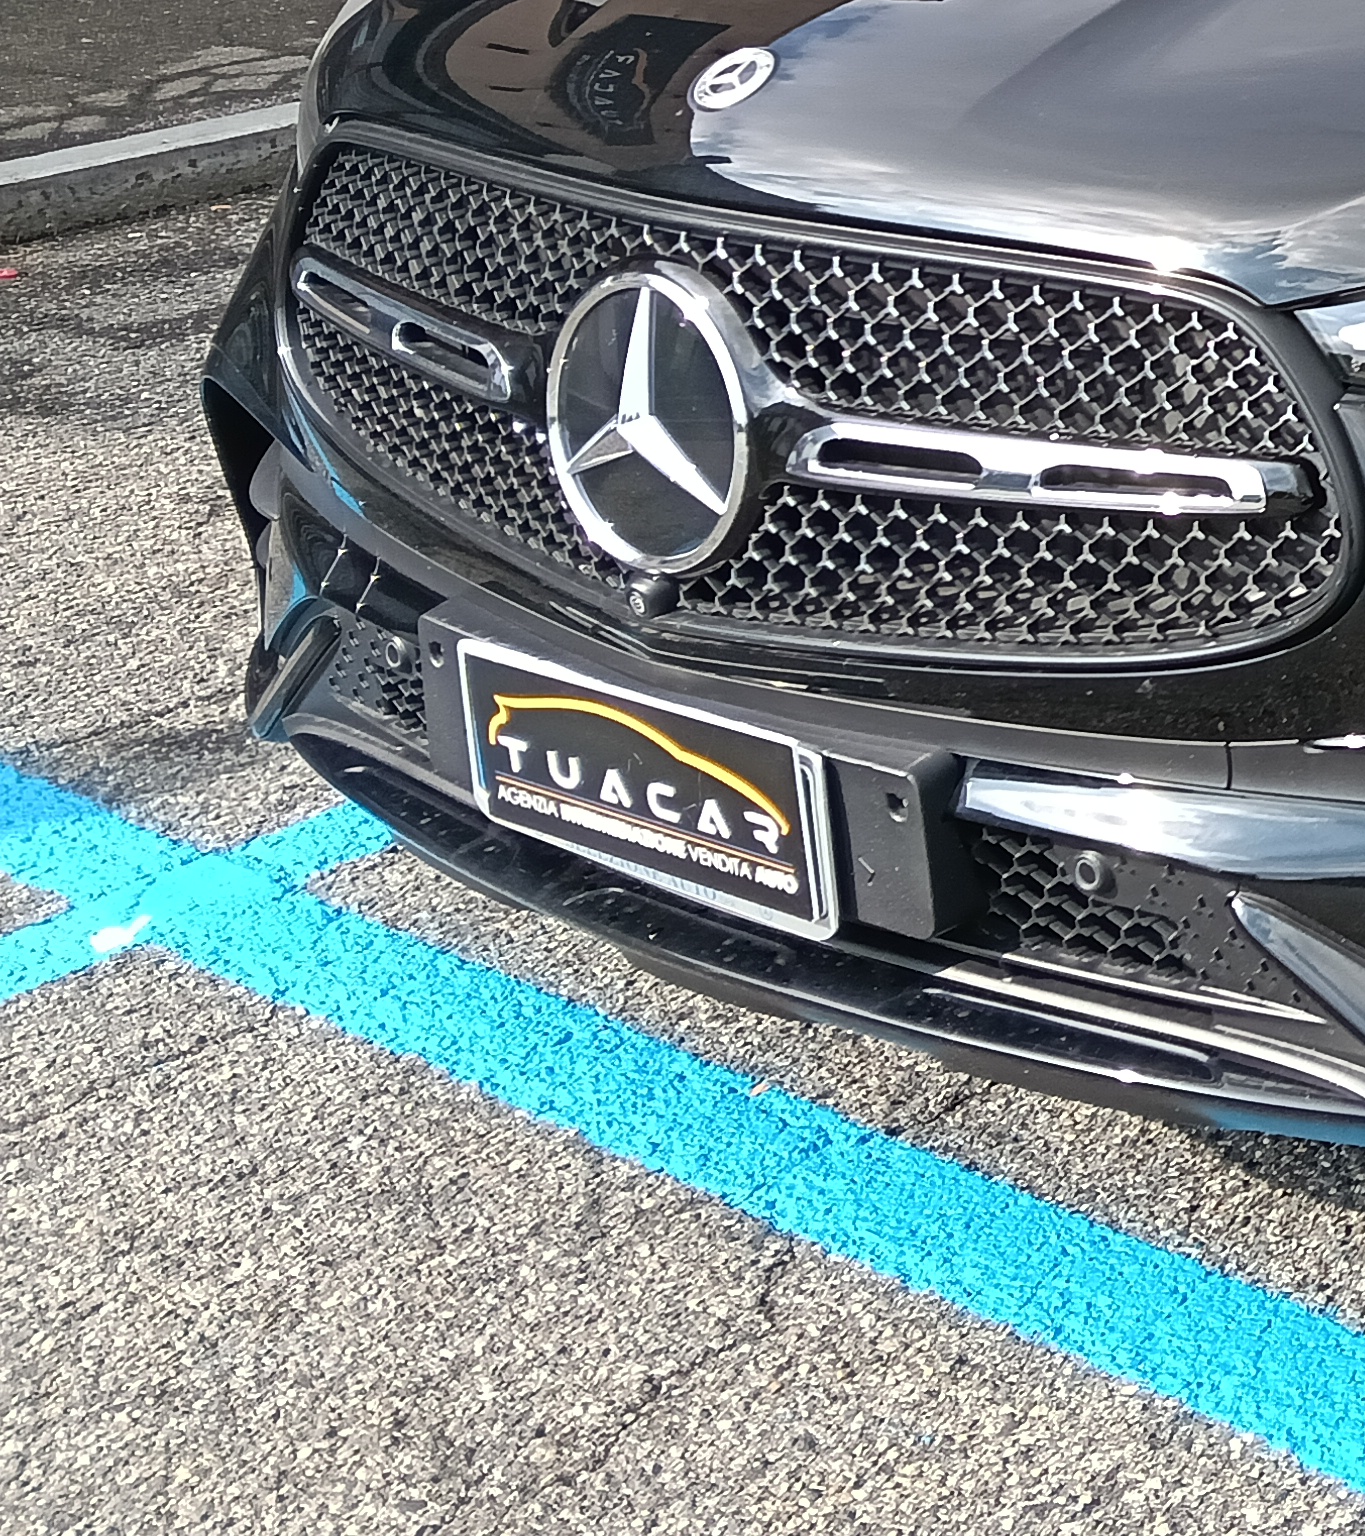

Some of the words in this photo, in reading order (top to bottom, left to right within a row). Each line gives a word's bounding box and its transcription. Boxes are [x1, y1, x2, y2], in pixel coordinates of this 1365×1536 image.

[497, 734, 781, 854] TUACAR
[498, 784, 560, 818] AGENZIA
[686, 843, 753, 881] VENDITA
